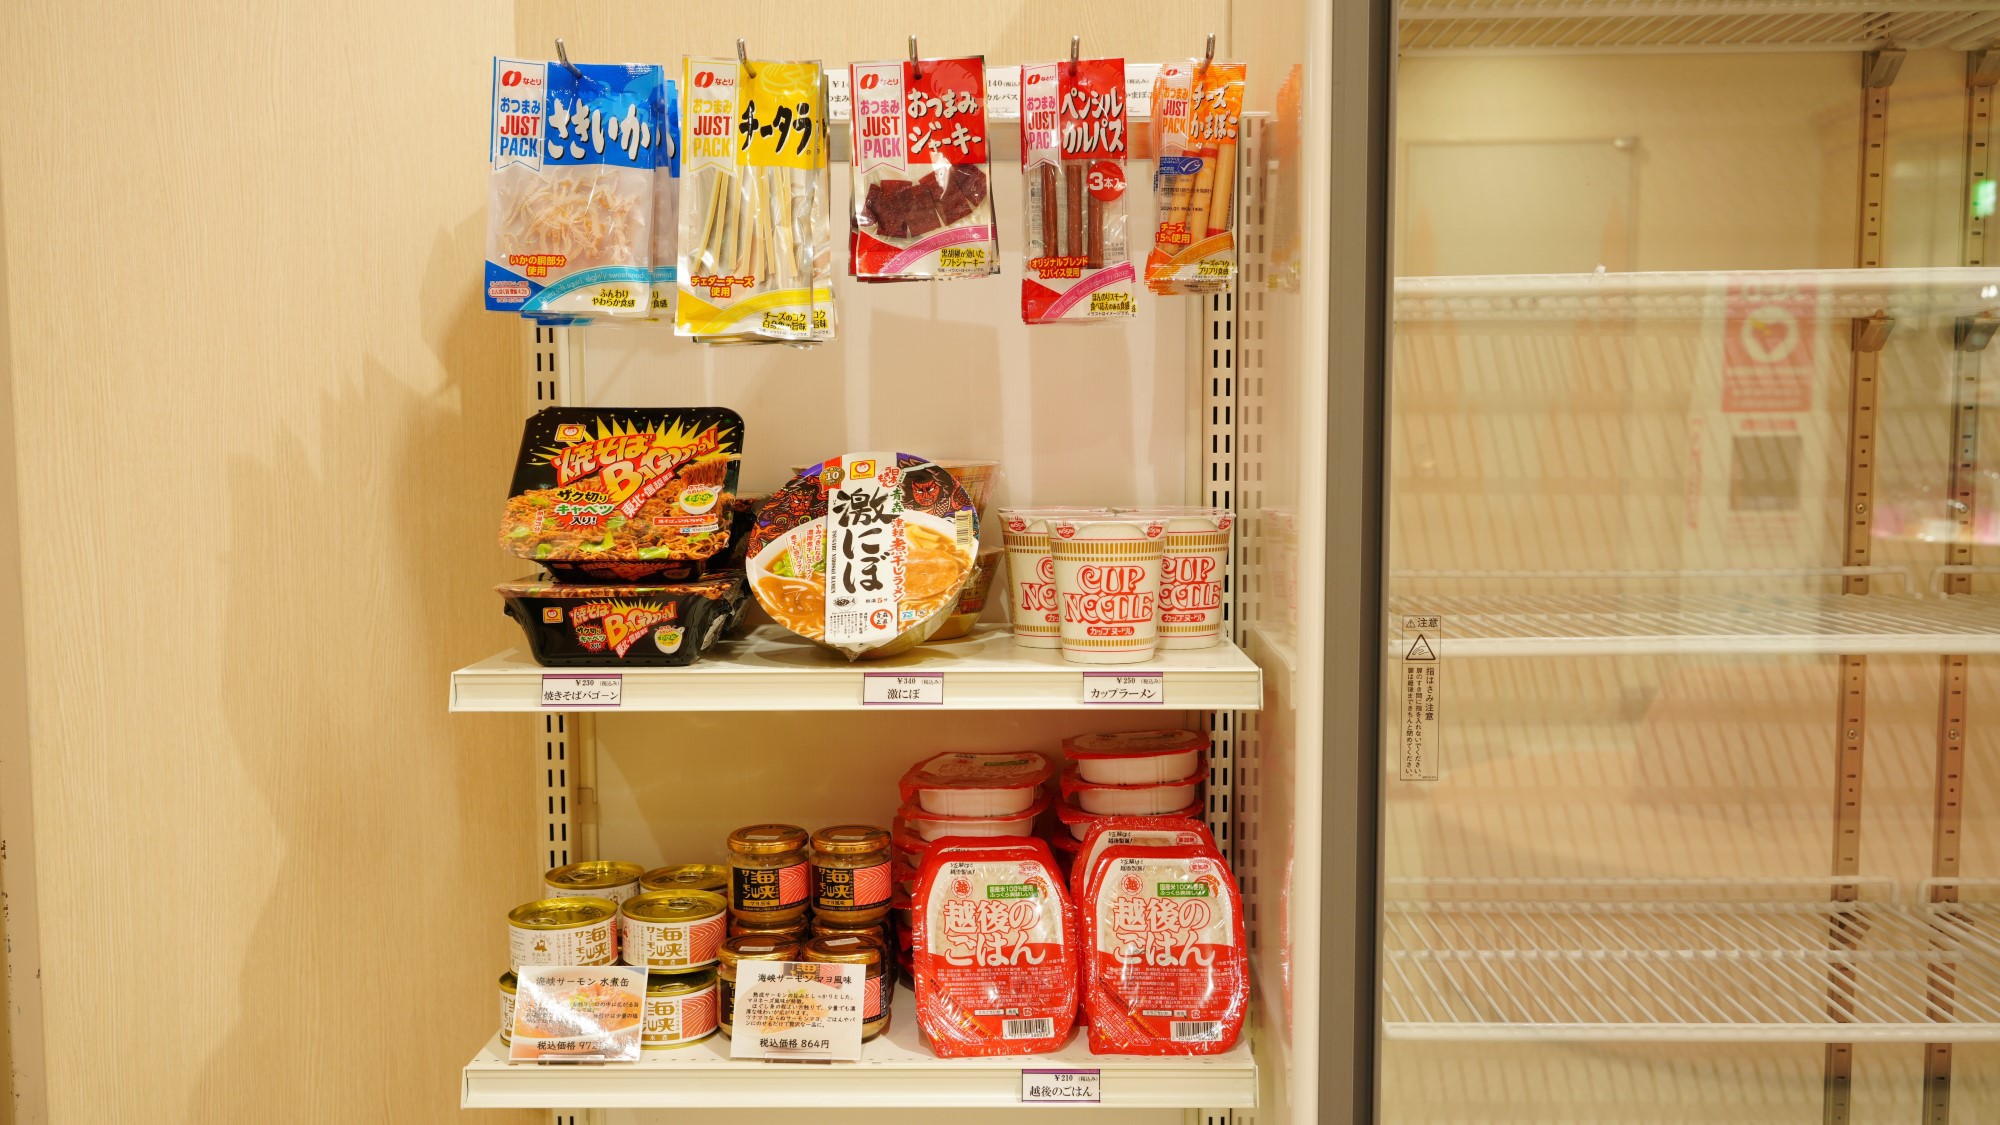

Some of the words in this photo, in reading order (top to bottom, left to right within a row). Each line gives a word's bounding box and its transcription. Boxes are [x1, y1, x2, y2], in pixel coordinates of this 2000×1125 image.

[523, 78, 542, 86] なとり
[1163, 87, 1188, 100] おつまみ
[1193, 81, 1229, 110] チーズ
[500, 96, 541, 114] おつまみ
[693, 99, 732, 114] おつまみ
[860, 100, 900, 115] おつまみ
[908, 88, 979, 119] おつまみ
[1027, 96, 1056, 110] おつまみ
[1061, 87, 1123, 119] ペンシル
[1164, 100, 1188, 116] JUST
[500, 116, 540, 136] JUST
[548, 98, 651, 160] さきいか
[694, 116, 731, 136] JUST
[863, 116, 900, 137] JUST
[1028, 111, 1056, 130] JUST
[1163, 118, 1186, 134] PACK
[1192, 110, 1238, 140] かまぼこ
[908, 122, 982, 155] ジャーキー
[1029, 131, 1058, 150] PAC
[1064, 118, 1125, 154] カルパス
[500, 137, 538, 158] PACK
[693, 137, 731, 158] PACK
[864, 138, 902, 158] PACK
[1160, 223, 1185, 233] チーズ
[1156, 232, 1191, 244] 15%使用
[510, 255, 566, 266] いかの胴部分
[941, 249, 984, 258] 黒胡椒が効いた
[940, 258, 985, 267] ソフトジャーキー
[1031, 258, 1088, 268] オリジナルブレンド
[526, 267, 548, 277] 使用
[1040, 268, 1080, 278] スパイス使用
[691, 276, 754, 286] チェダーチーズ
[600, 290, 629, 298] ふんわり
[710, 287, 731, 298] 使用
[1092, 294, 1128, 302] ほんのりスモーク
[592, 298, 636, 307] やわらか食感
[1090, 302, 1130, 312] 食べ応えのある食感
[764, 312, 806, 321] チーズのコク
[556, 434, 656, 485] 焼そば
[824, 471, 840, 481] 10
[557, 489, 608, 502] ザク切り
[890, 488, 904, 513] 青森
[555, 502, 616, 516] キャベツ
[832, 487, 899, 594] 激にぼ
[890, 518, 907, 602] 津軽煮干しラーメン
[1160, 556, 1216, 582] CUP
[1077, 564, 1146, 594] CUP
[1158, 580, 1222, 611] OODLE
[570, 603, 612, 626] 焼そば
[1062, 592, 1154, 624] NOODLE
[1089, 626, 1132, 636] カップヌードル
[1417, 618, 1439, 628] 注意
[580, 634, 606, 643] キャベツ
[544, 690, 618, 701] 焼きそばバゴーン
[888, 688, 920, 700] 激にぼ
[1091, 688, 1156, 698] カップラーメン
[1424, 667, 1434, 720] 指はさみ注意
[1414, 668, 1422, 777] 扉のすき間に指を入れないでください。
[751, 869, 776, 899] 海峡
[826, 868, 851, 899] 海峡
[943, 900, 1040, 934] 越後の
[1113, 896, 1210, 932] 越後の
[575, 931, 586, 962] サーモン
[585, 925, 608, 961] 海峡
[656, 926, 684, 958] 海峡
[945, 931, 1046, 966] ごはん
[1114, 930, 1216, 966] ごはん
[536, 976, 596, 987] 海峡サーモン
[600, 976, 630, 987] 水煮缶
[758, 974, 814, 983] 海峡サーモン
[816, 976, 852, 984] マヨ風味
[647, 1001, 676, 1033] 海峡
[537, 1040, 576, 1050] 税込価格
[760, 1038, 798, 1048] 税込価格
[801, 1040, 830, 1048] 864円
[1030, 1086, 1093, 1098] 越後のごはん
